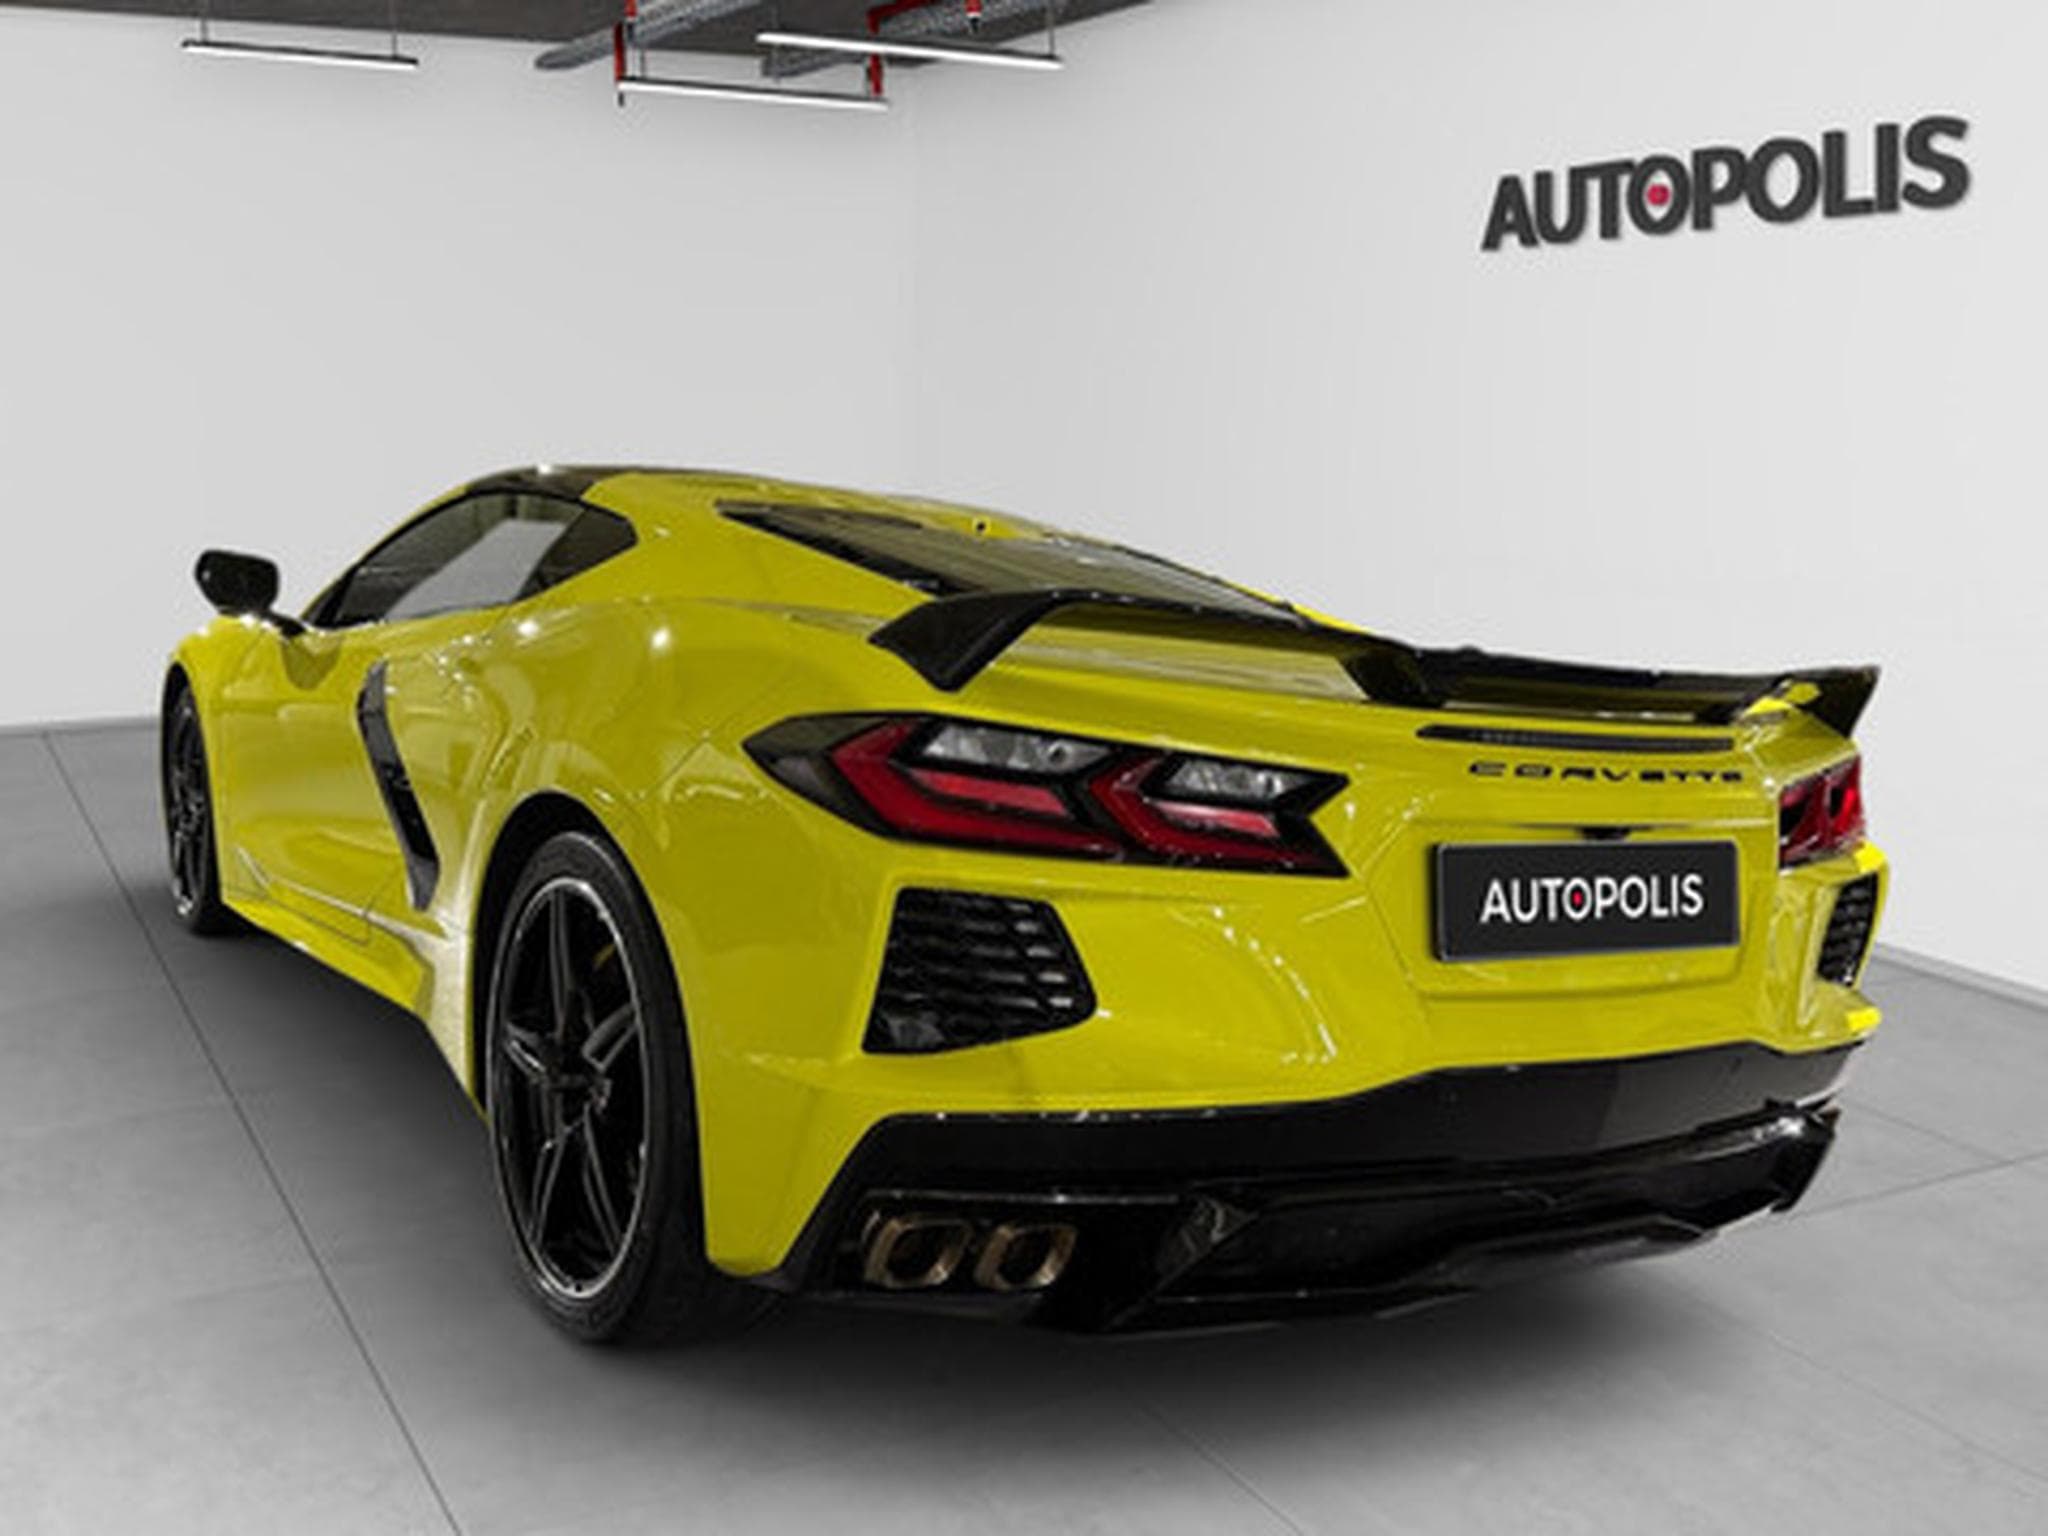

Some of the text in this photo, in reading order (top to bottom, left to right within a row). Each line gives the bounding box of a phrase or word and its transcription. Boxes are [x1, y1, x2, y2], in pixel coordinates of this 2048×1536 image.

[1481, 116, 1971, 251] AUTOPOLIS
[1468, 761, 1742, 782] CORVETTE
[1479, 873, 1704, 923] AUTOPOLIS
